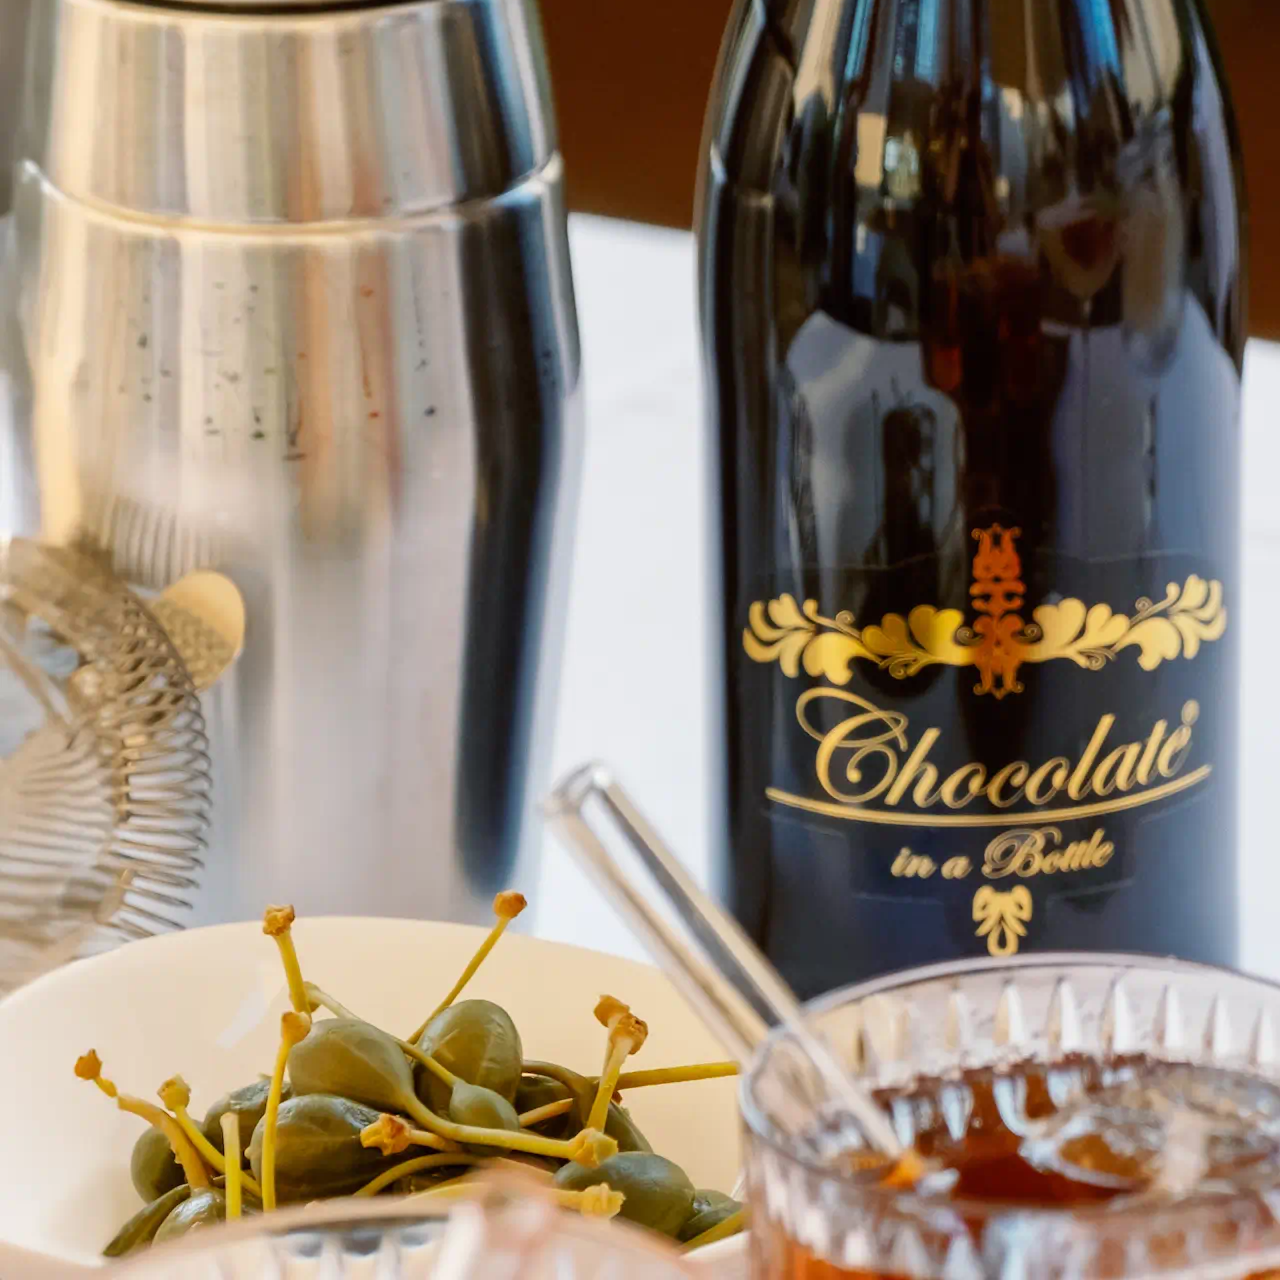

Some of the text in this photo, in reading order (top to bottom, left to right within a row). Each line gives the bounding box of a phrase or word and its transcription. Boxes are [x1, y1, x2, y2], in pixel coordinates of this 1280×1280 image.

[891, 825, 1115, 880] in a Bottle
